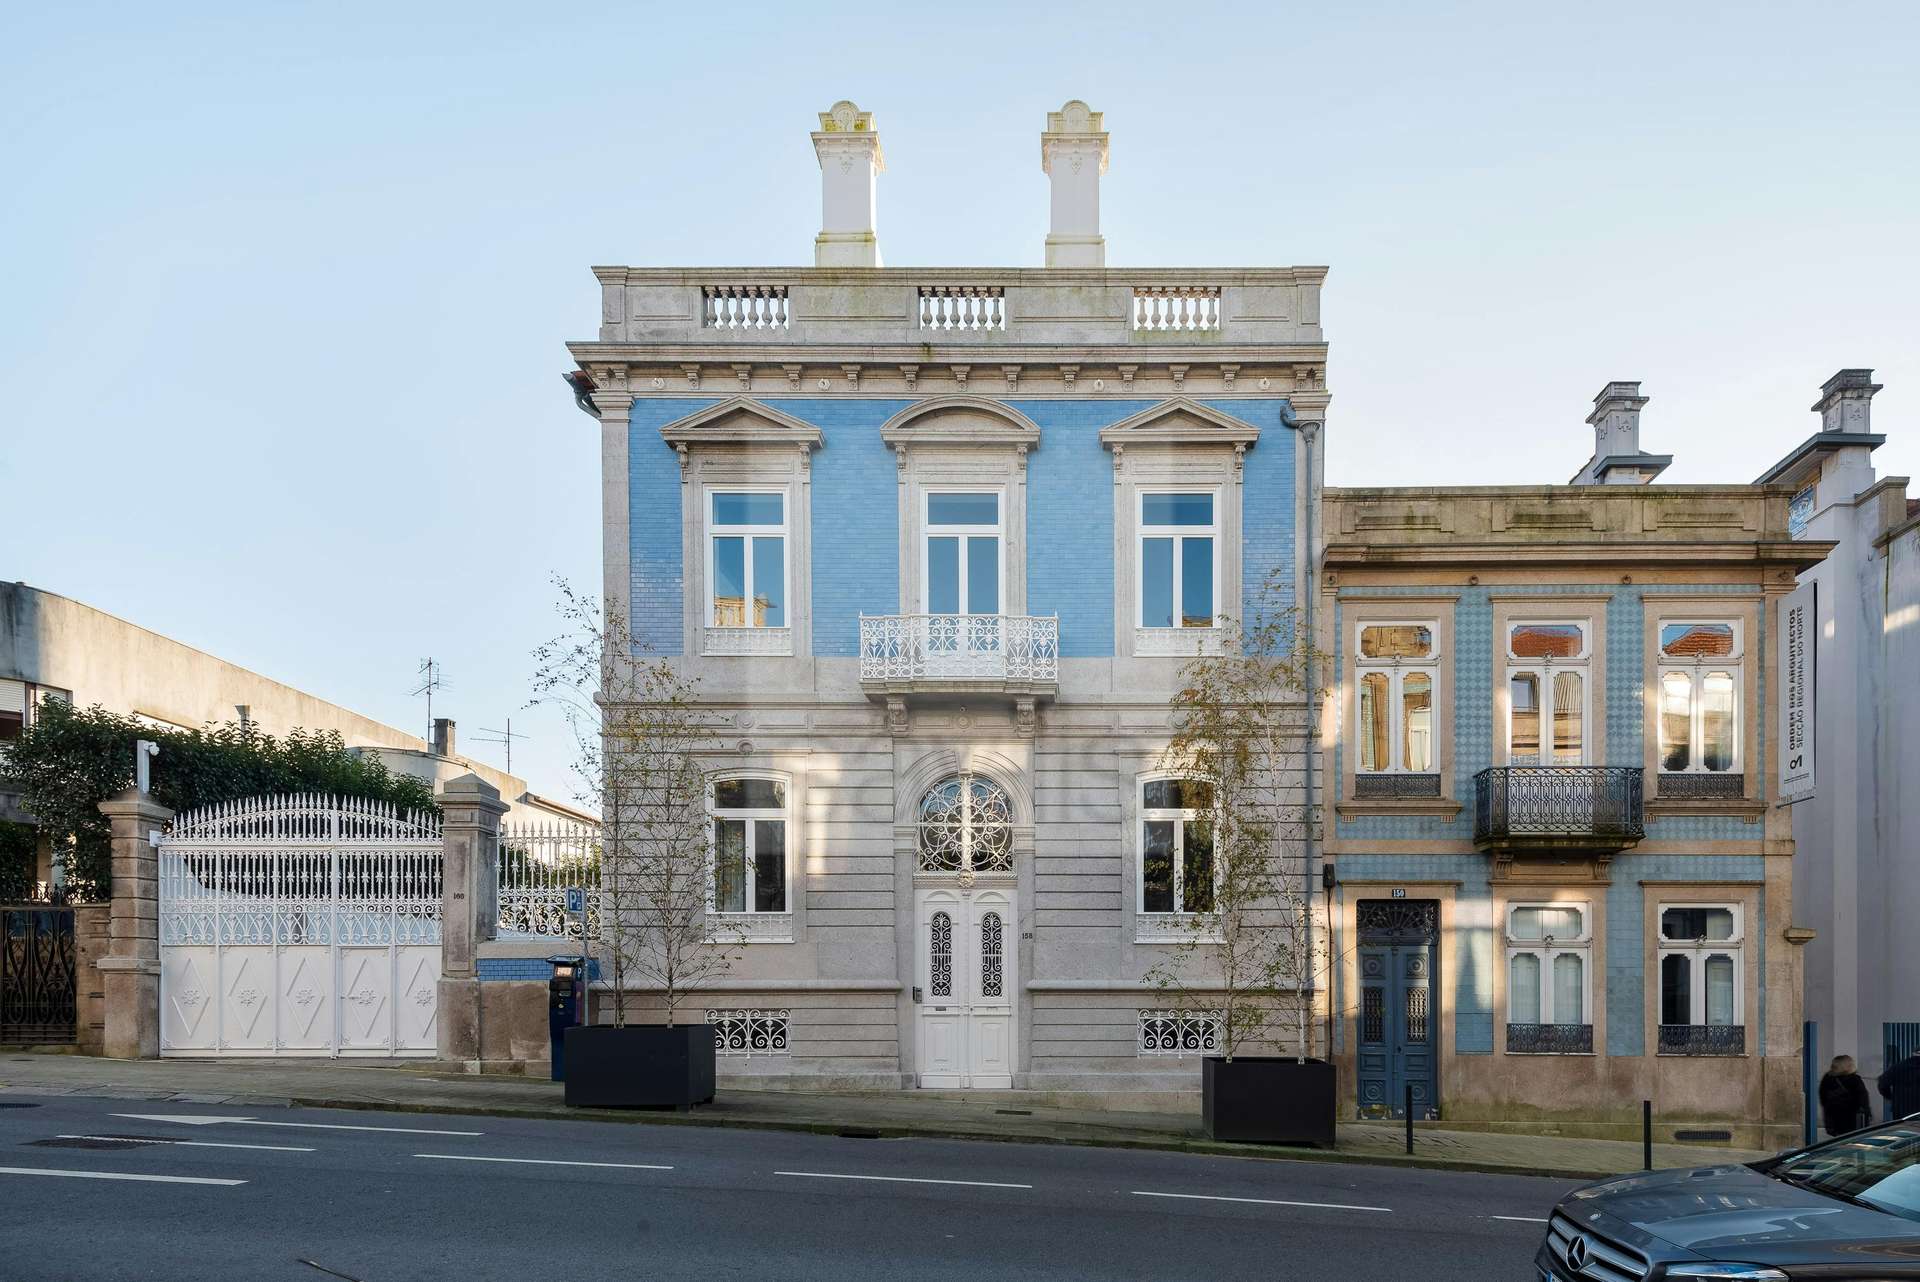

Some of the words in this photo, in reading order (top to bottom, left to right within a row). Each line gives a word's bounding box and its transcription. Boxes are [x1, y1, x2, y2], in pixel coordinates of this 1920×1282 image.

[1796, 604, 1804, 640] NORTE
[1788, 608, 1796, 684] ARQUITECTOS
[1796, 641, 1804, 657] DO
[1796, 657, 1804, 708] REGIONAL
[1796, 709, 1804, 749] SECÇÃO
[569, 890, 577, 910] P
[1393, 889, 1405, 897] 150
